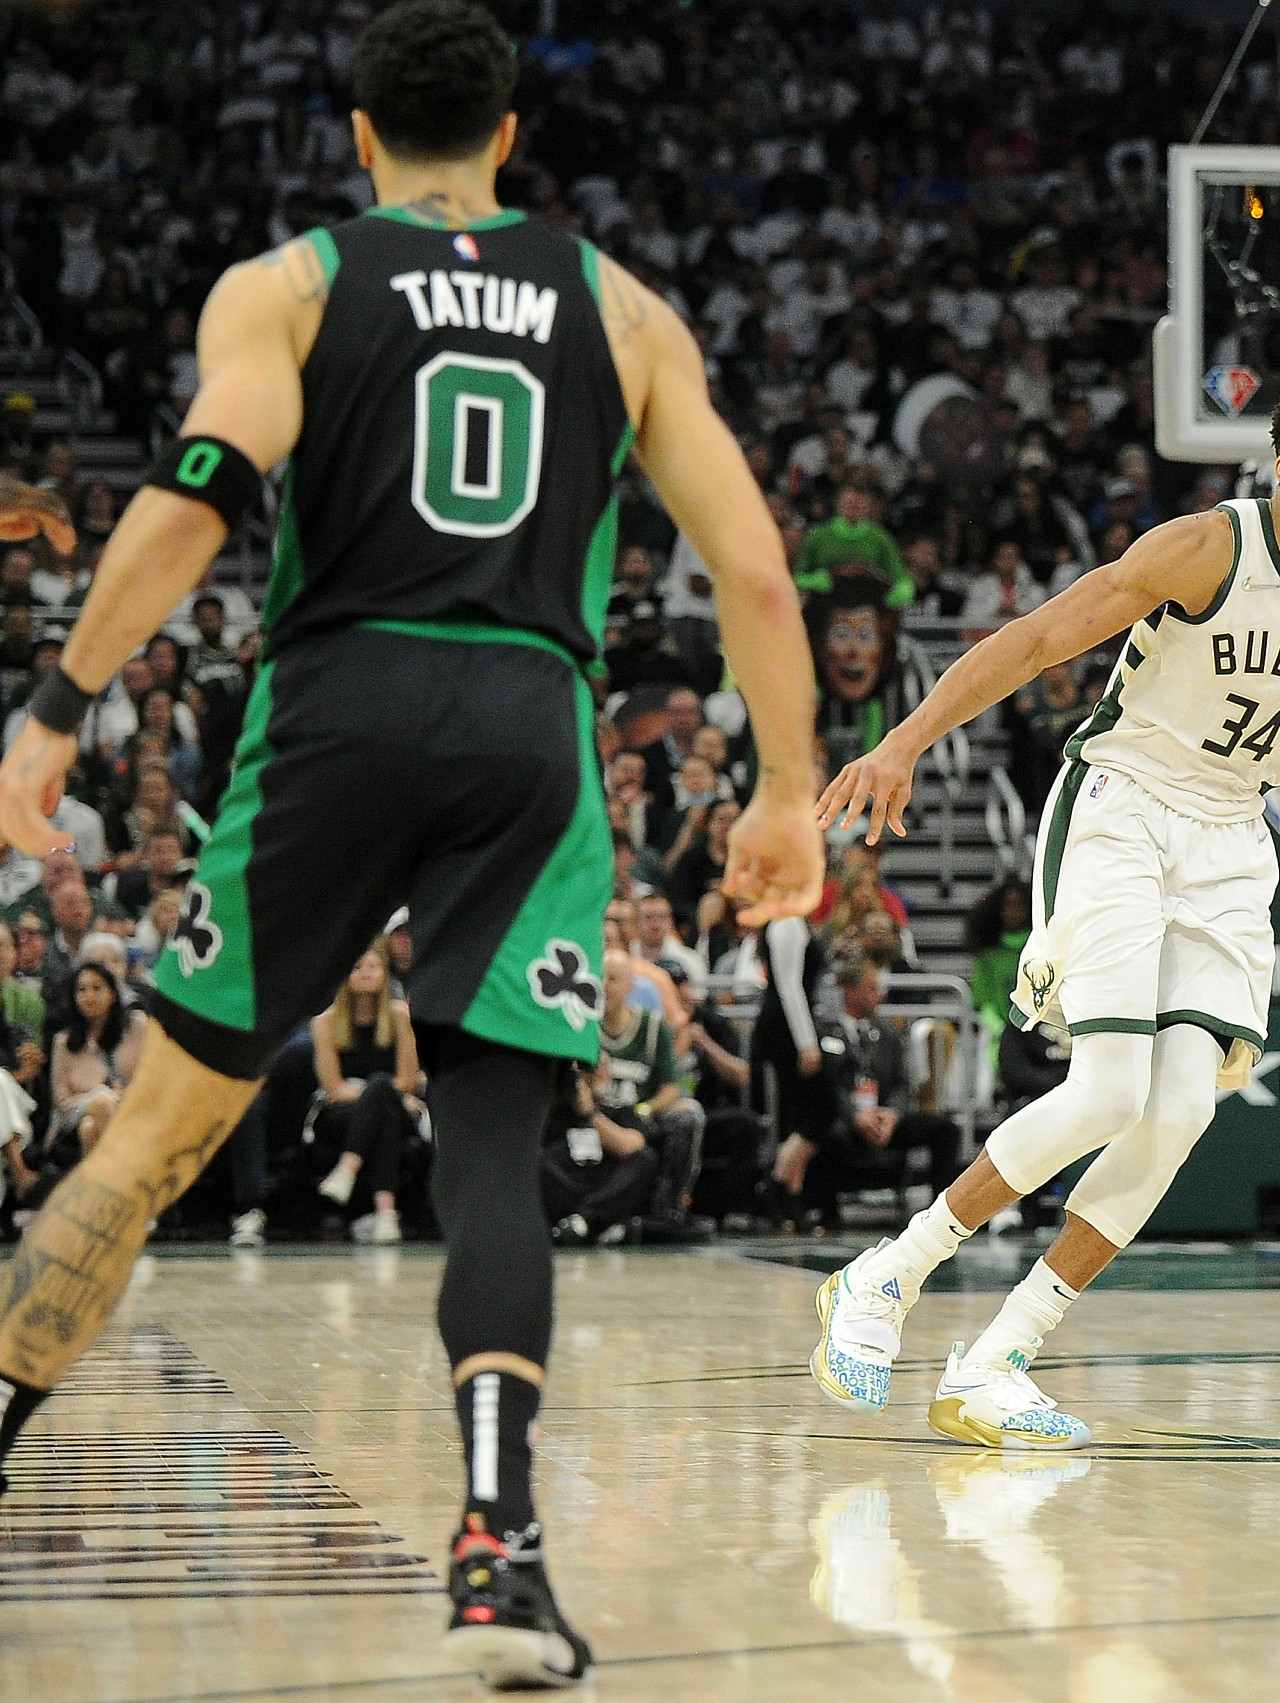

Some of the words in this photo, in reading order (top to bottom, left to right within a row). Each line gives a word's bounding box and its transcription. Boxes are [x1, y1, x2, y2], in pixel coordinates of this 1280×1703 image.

[390, 270, 559, 344] TATUM
[176, 441, 223, 488] 0
[411, 351, 545, 538] 0
